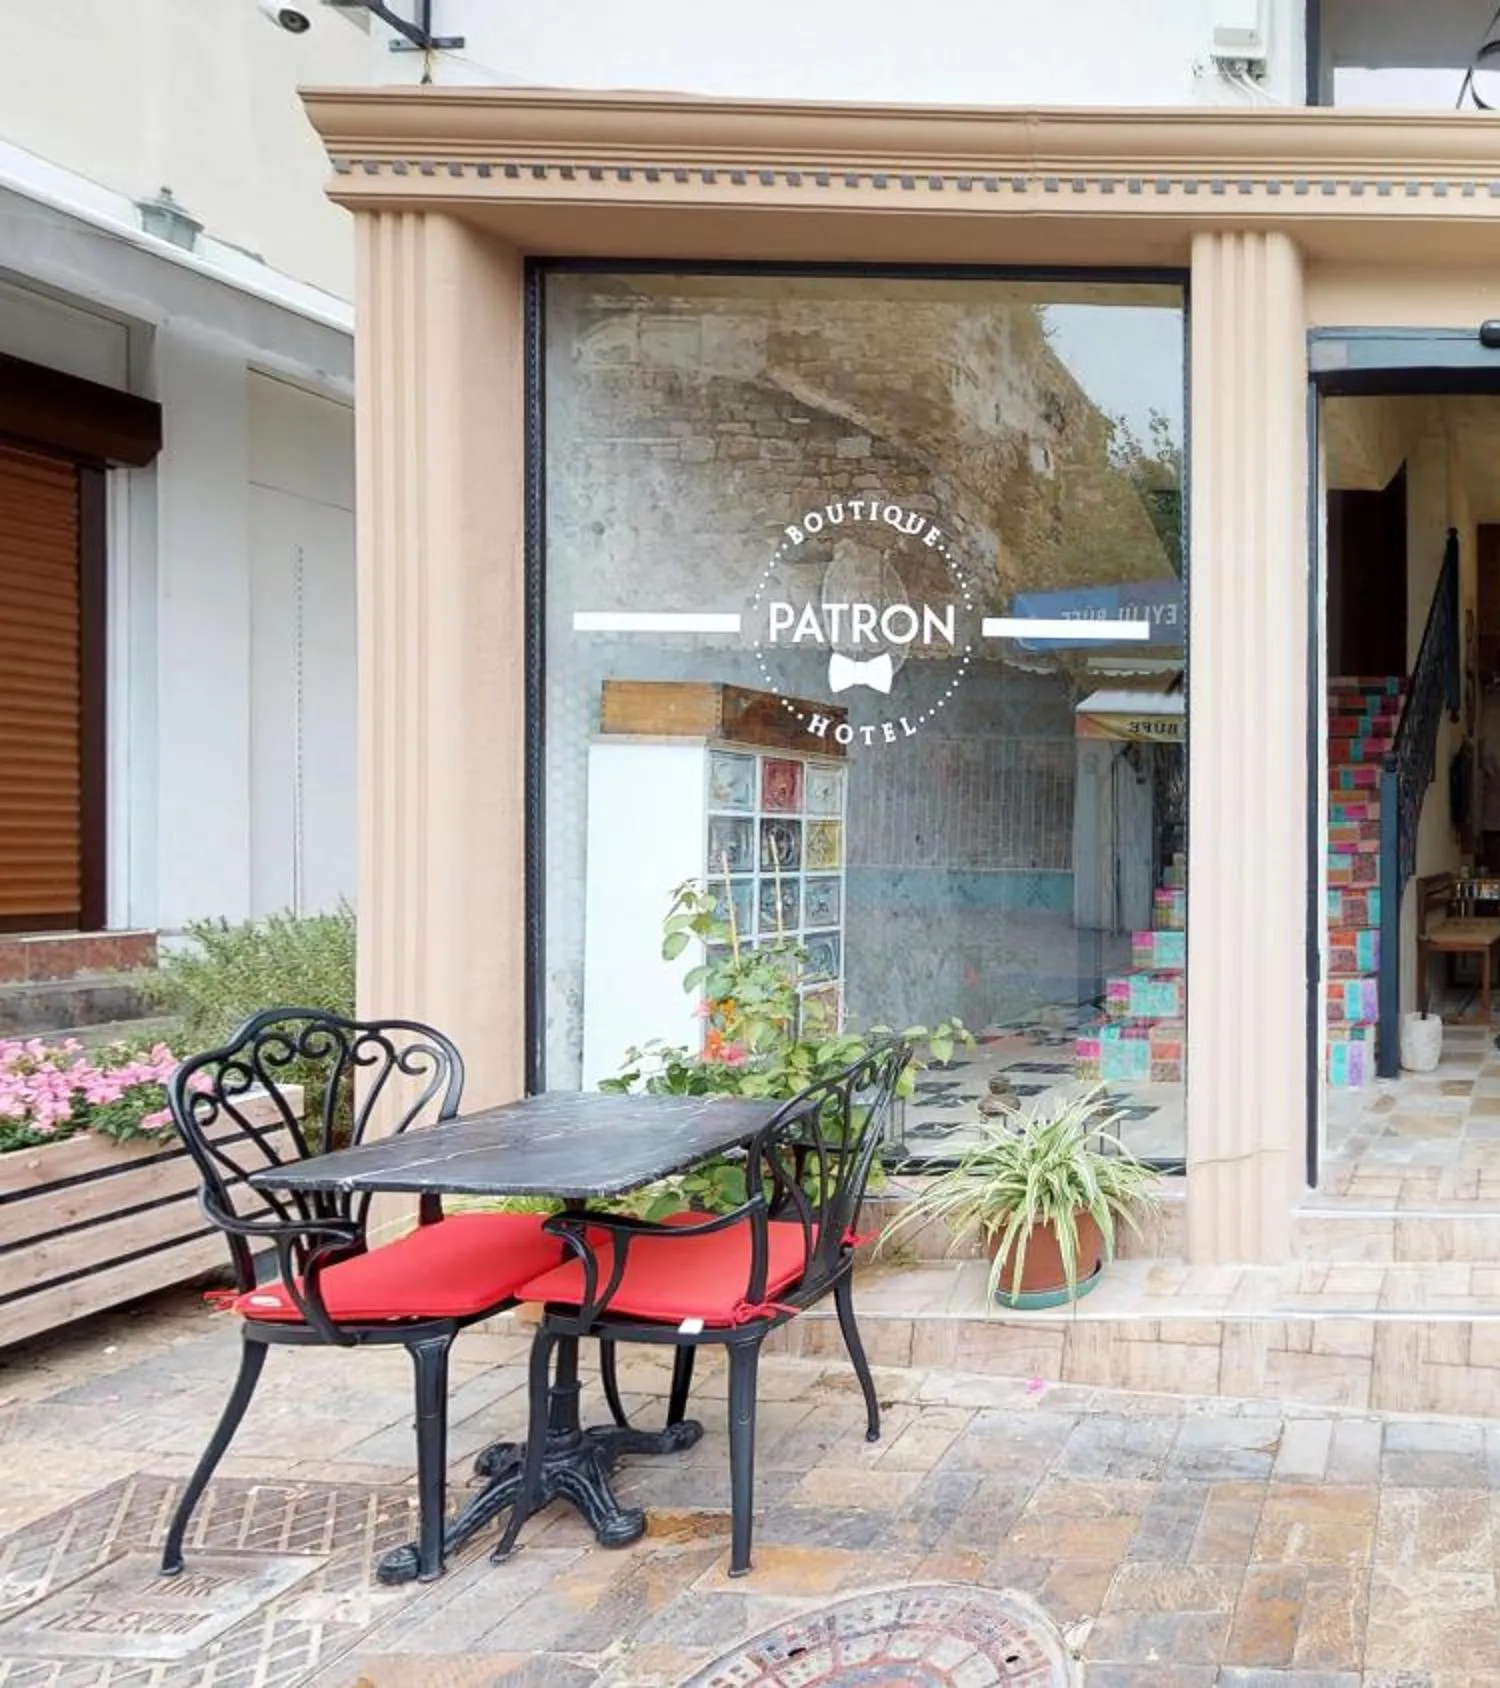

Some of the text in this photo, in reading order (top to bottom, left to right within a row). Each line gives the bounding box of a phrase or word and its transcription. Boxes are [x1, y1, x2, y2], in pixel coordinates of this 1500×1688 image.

[785, 501, 942, 546] BOUTIQUE
[769, 601, 955, 645] PATRON
[807, 713, 916, 745] HOTEL
